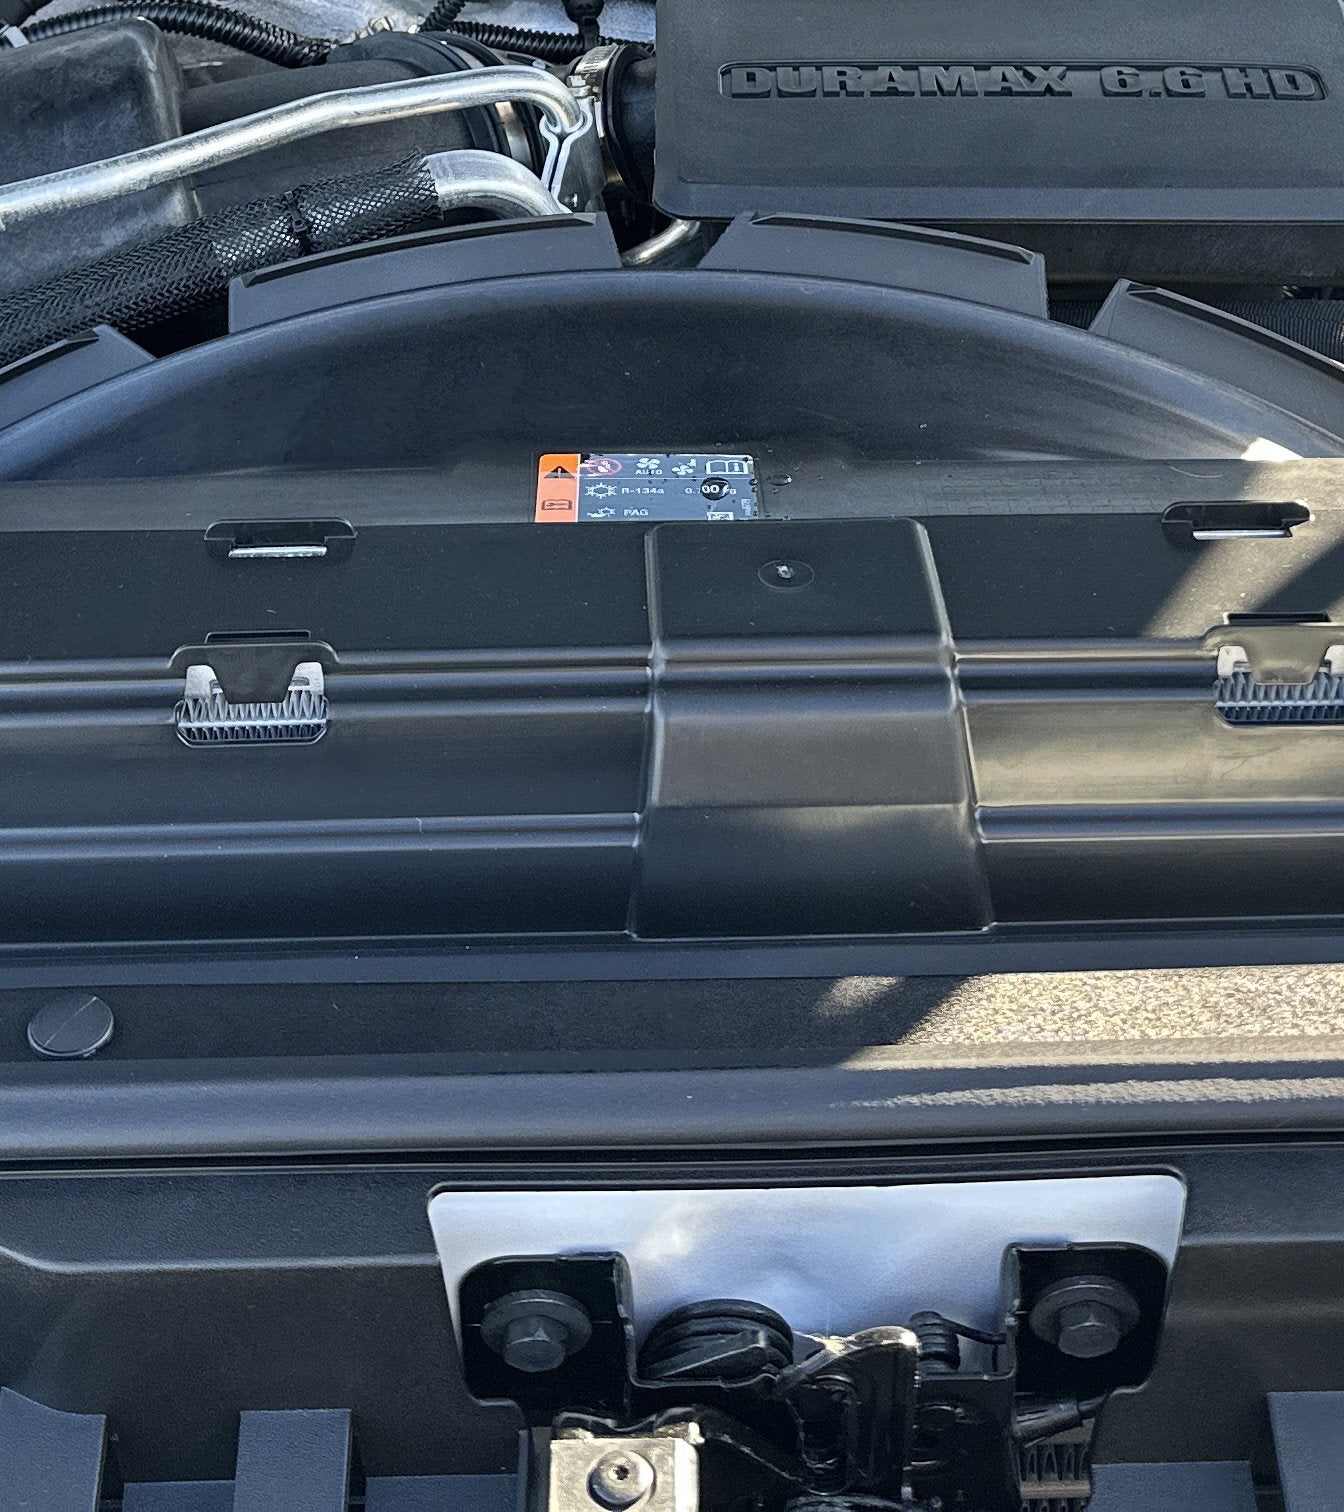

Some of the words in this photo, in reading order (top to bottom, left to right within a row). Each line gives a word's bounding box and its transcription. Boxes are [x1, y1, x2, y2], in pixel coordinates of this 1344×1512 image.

[730, 66, 1073, 97] DURAMAX
[1100, 66, 1207, 97] 6.6
[1222, 67, 1324, 100] HD
[623, 508, 649, 516] PAG
